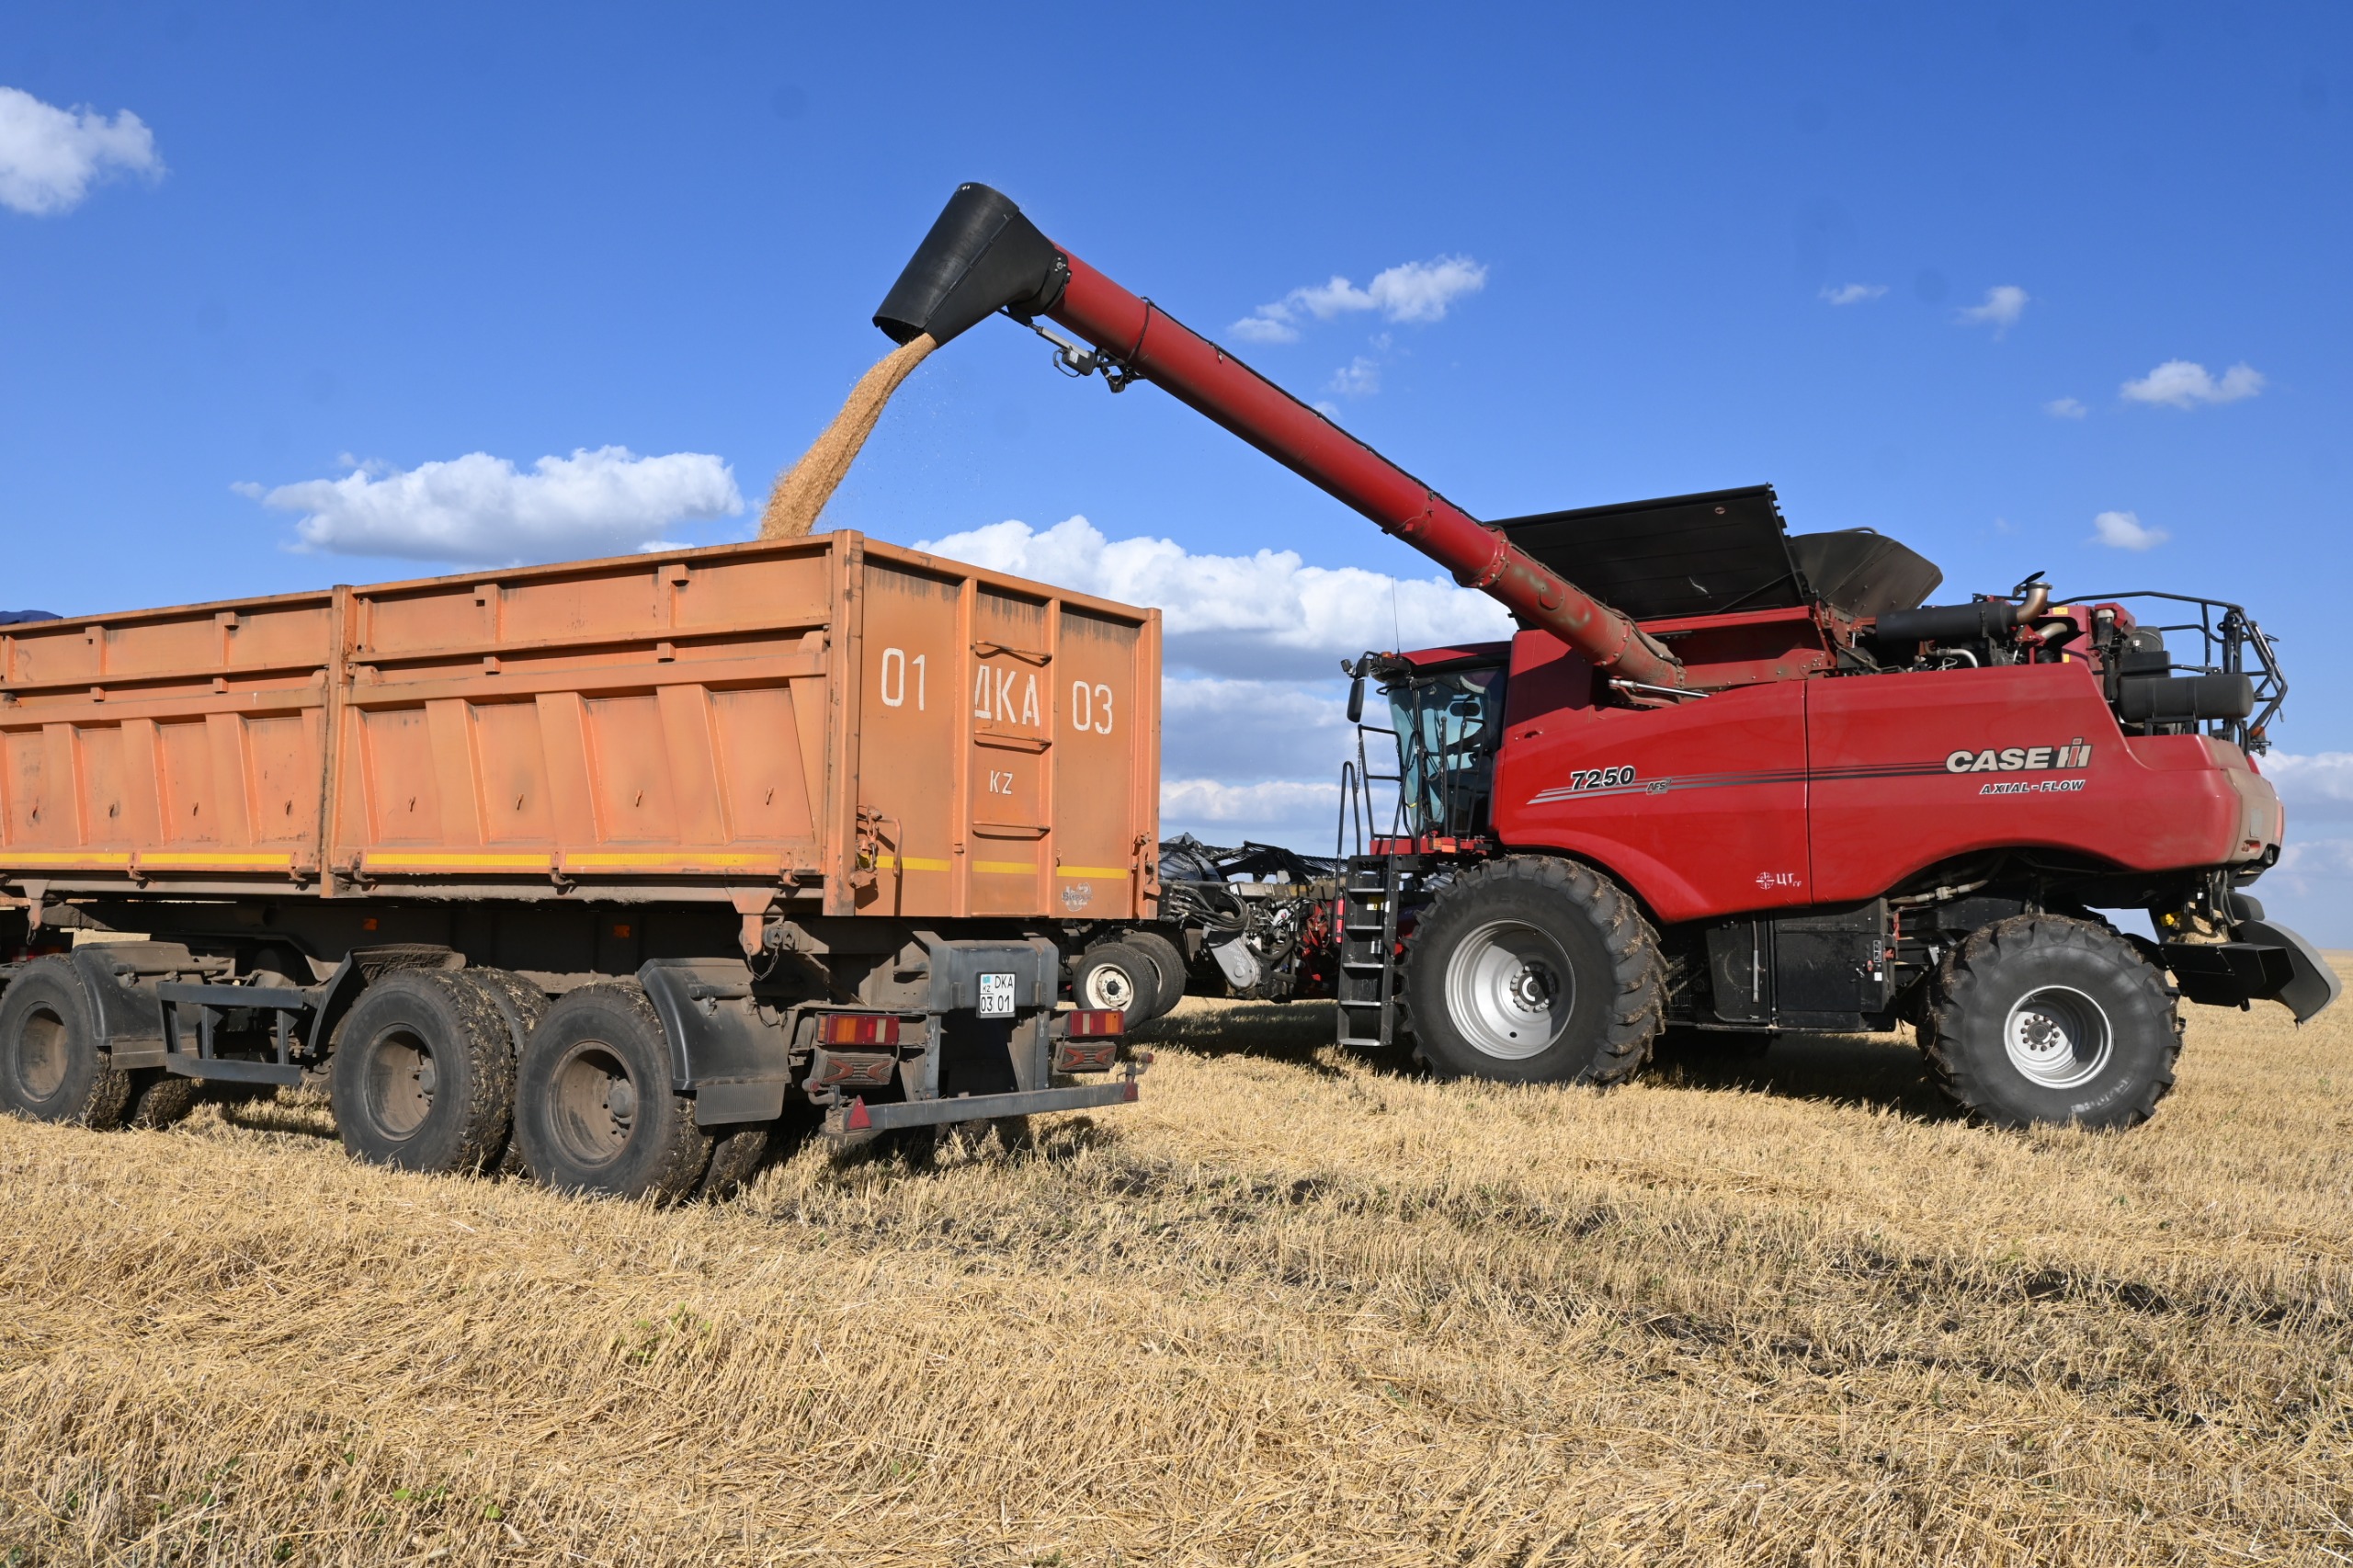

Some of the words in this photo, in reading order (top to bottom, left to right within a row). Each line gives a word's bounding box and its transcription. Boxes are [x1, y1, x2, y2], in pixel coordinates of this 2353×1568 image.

[881, 647, 926, 711] 01
[1072, 680, 1113, 734] 03
[1946, 746, 2053, 773] CASE
[990, 770, 1013, 795] KZ
[1570, 766, 1636, 791] 7250
[1646, 781, 1666, 791] AFS
[995, 975, 1014, 989] DKA
[980, 996, 993, 1012] 03
[997, 994, 1010, 1012] 01
